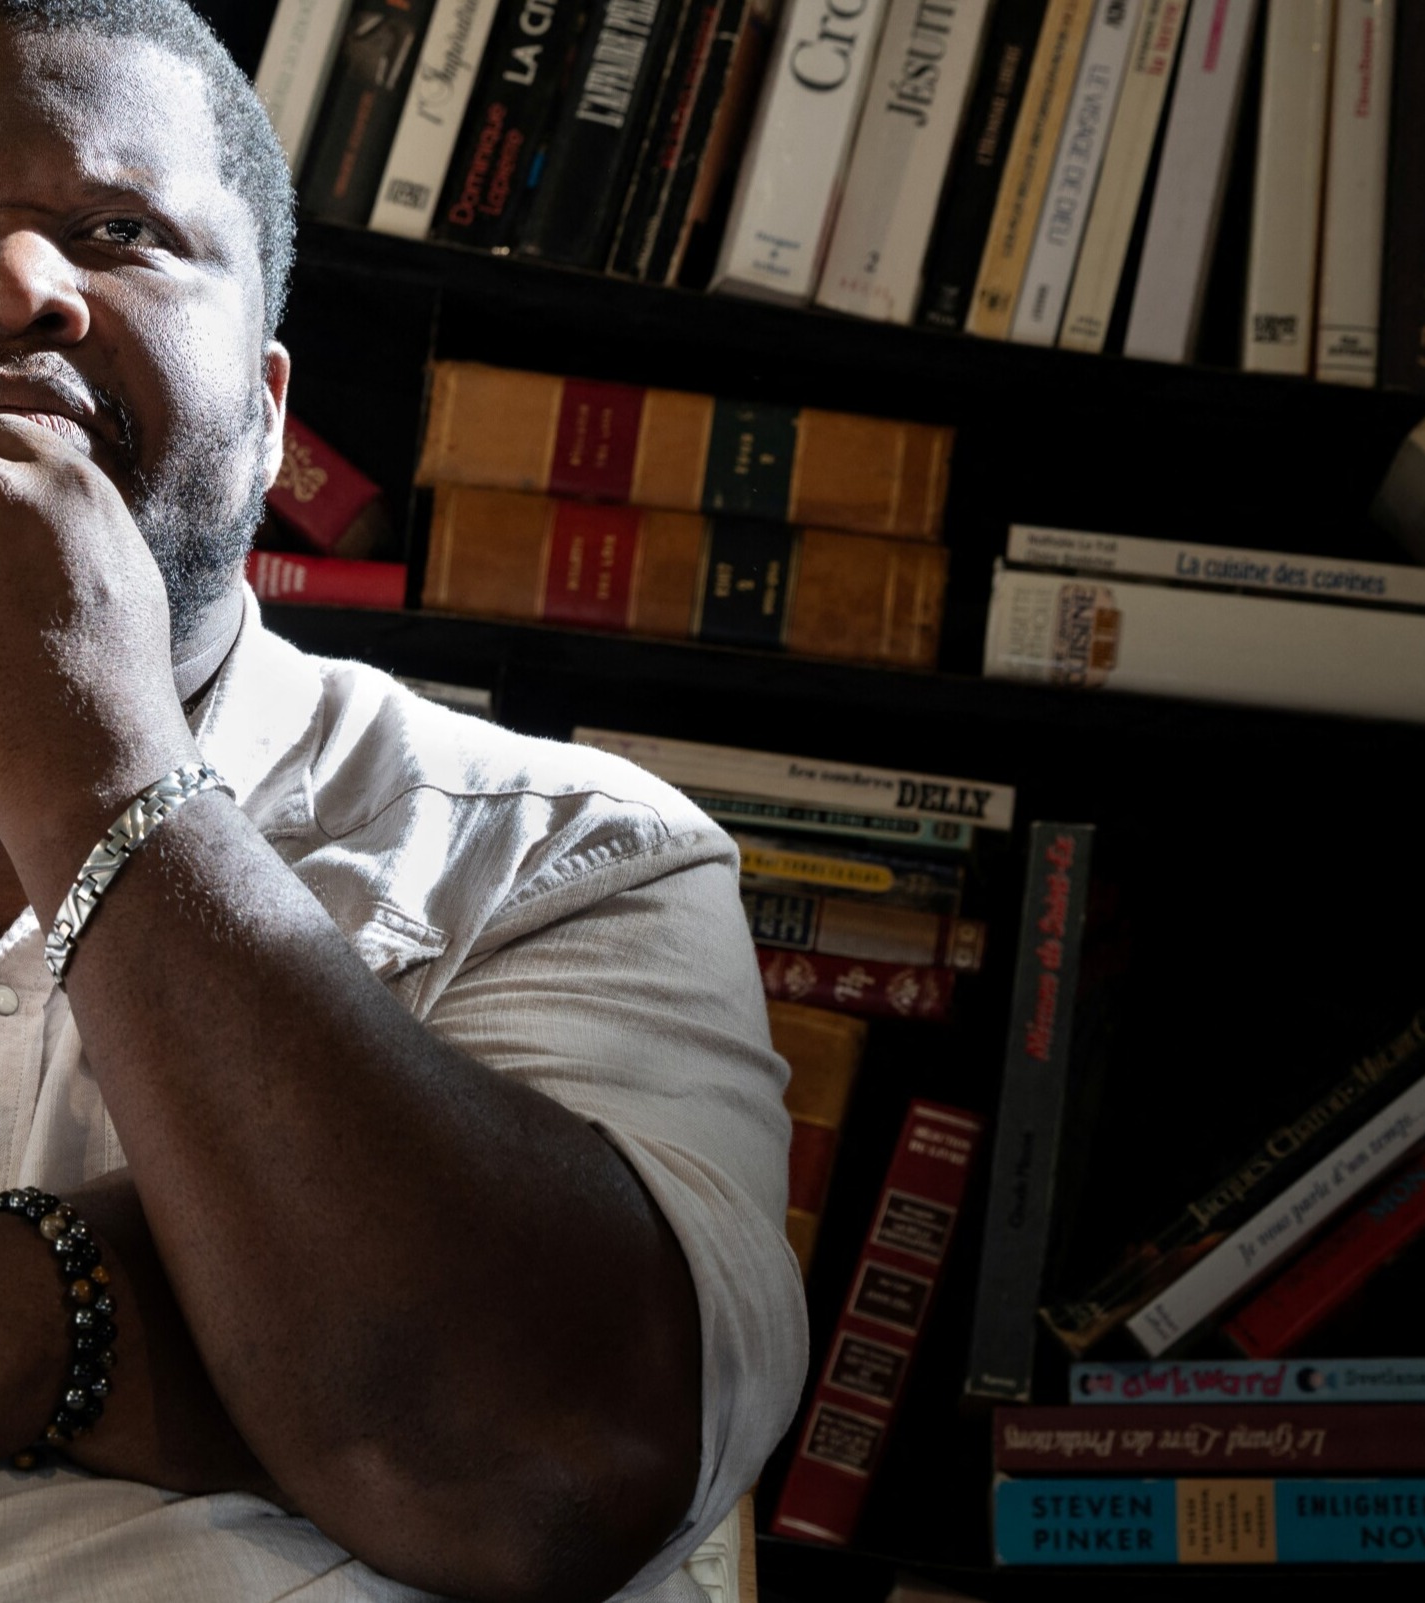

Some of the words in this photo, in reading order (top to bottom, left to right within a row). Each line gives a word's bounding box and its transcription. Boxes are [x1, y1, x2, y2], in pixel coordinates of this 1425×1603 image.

[502, 44, 544, 87] LA
[1085, 61, 1113, 89] LE
[448, 101, 508, 226] Dominique
[1176, 552, 1201, 577] La
[1203, 558, 1270, 583] cuisine
[1272, 563, 1308, 587] des
[1311, 569, 1386, 596] copines
[894, 777, 993, 820] DELLY
[1121, 1362, 1286, 1398] awkward
[1117, 1427, 1153, 1455] des
[1155, 1421, 1223, 1456] Livre
[1224, 1421, 1294, 1458] Grand
[1296, 1427, 1325, 1456] Le
[1032, 1494, 1154, 1519] STEVEN
[1297, 1494, 1425, 1517] ENLIGHTE
[1034, 1528, 1154, 1551] PINKER
